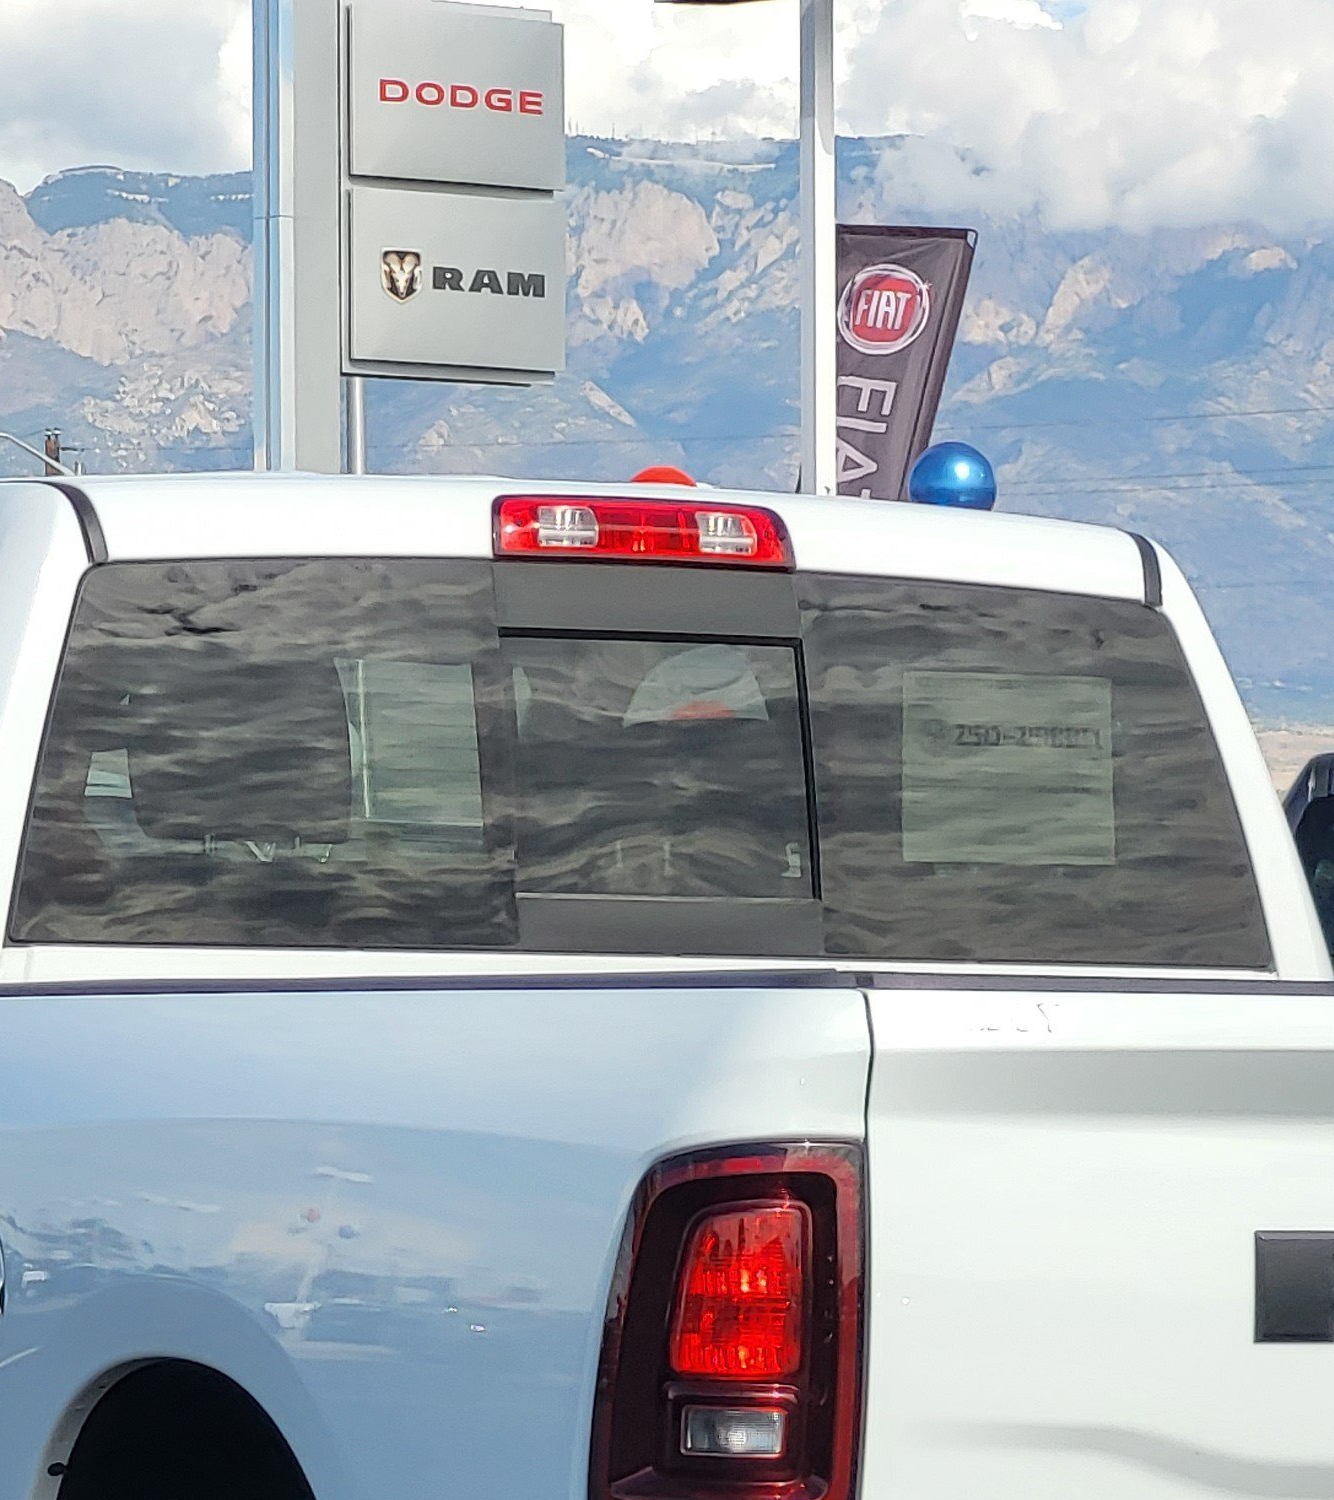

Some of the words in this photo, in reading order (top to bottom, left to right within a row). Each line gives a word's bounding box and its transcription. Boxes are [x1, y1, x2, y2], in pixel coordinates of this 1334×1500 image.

[379, 78, 544, 116] DODGE
[431, 265, 546, 298] RAM
[854, 289, 914, 331] FIAT
[836, 374, 898, 500] FIA
